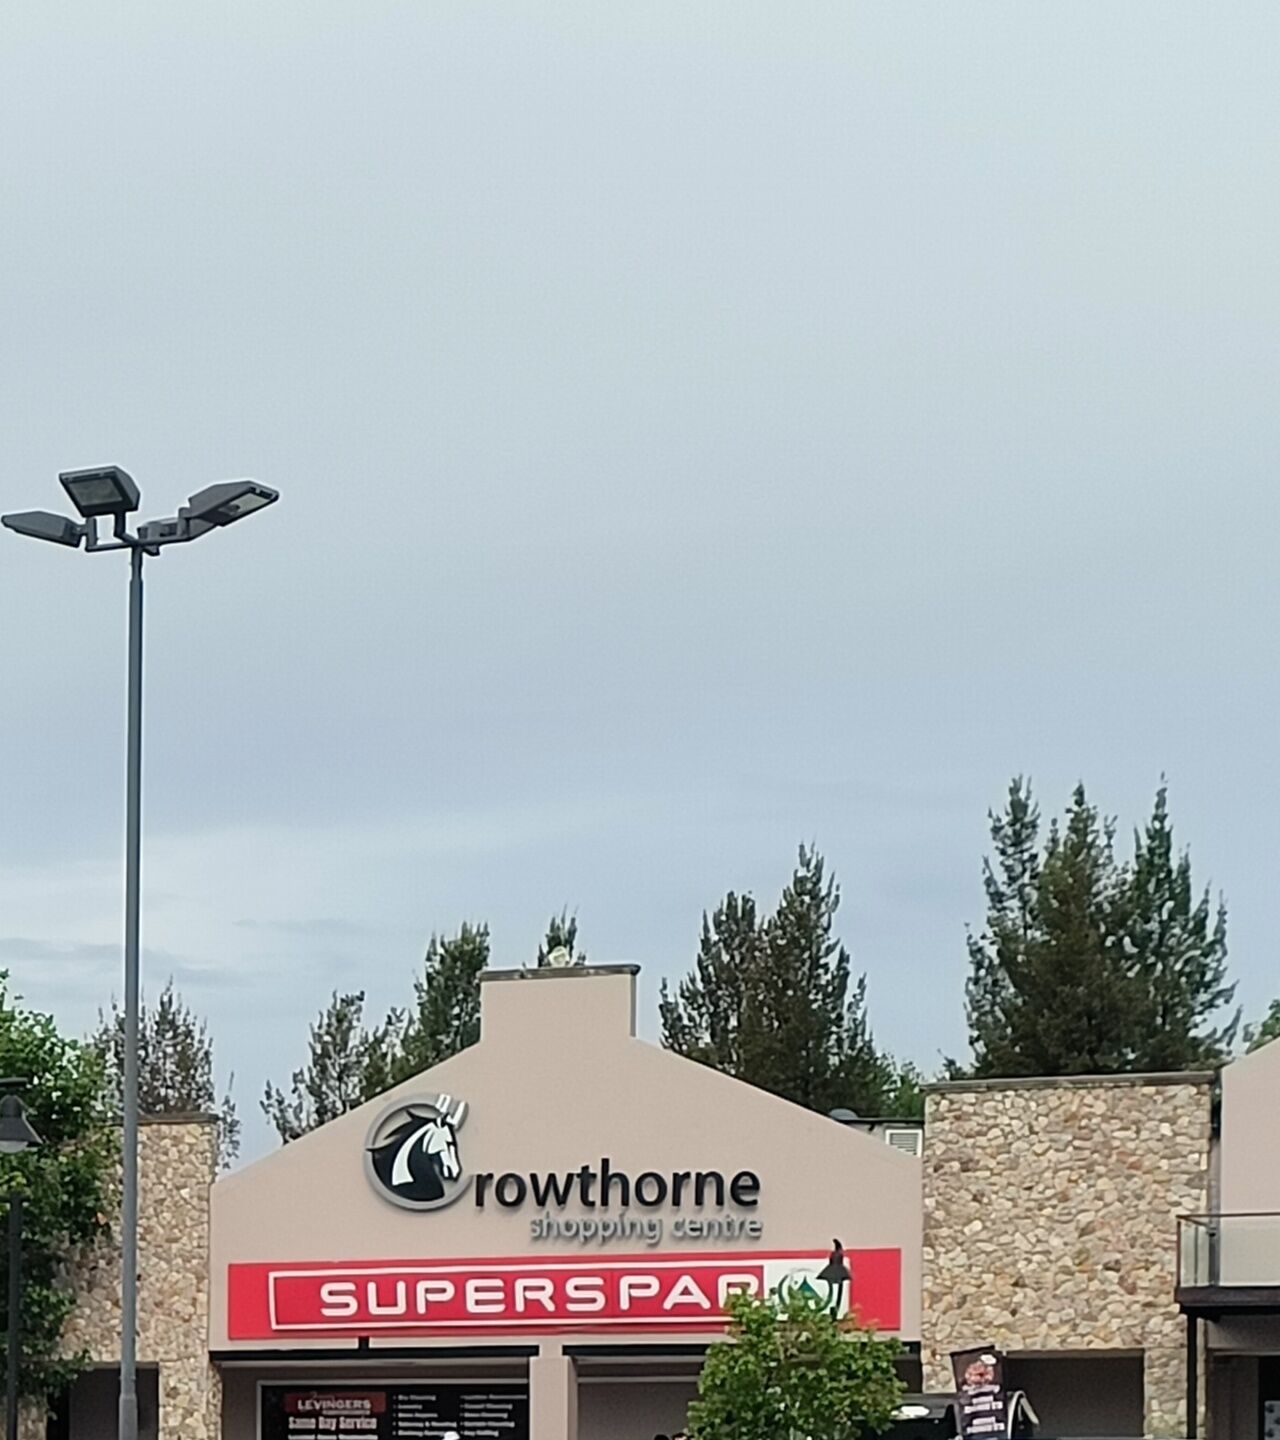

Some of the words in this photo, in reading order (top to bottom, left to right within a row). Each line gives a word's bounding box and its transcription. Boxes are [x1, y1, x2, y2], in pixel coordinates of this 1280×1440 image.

[530, 1212, 664, 1243] shopping
[671, 1214, 763, 1239] centre
[297, 1399, 371, 1410] LEVINGERS
